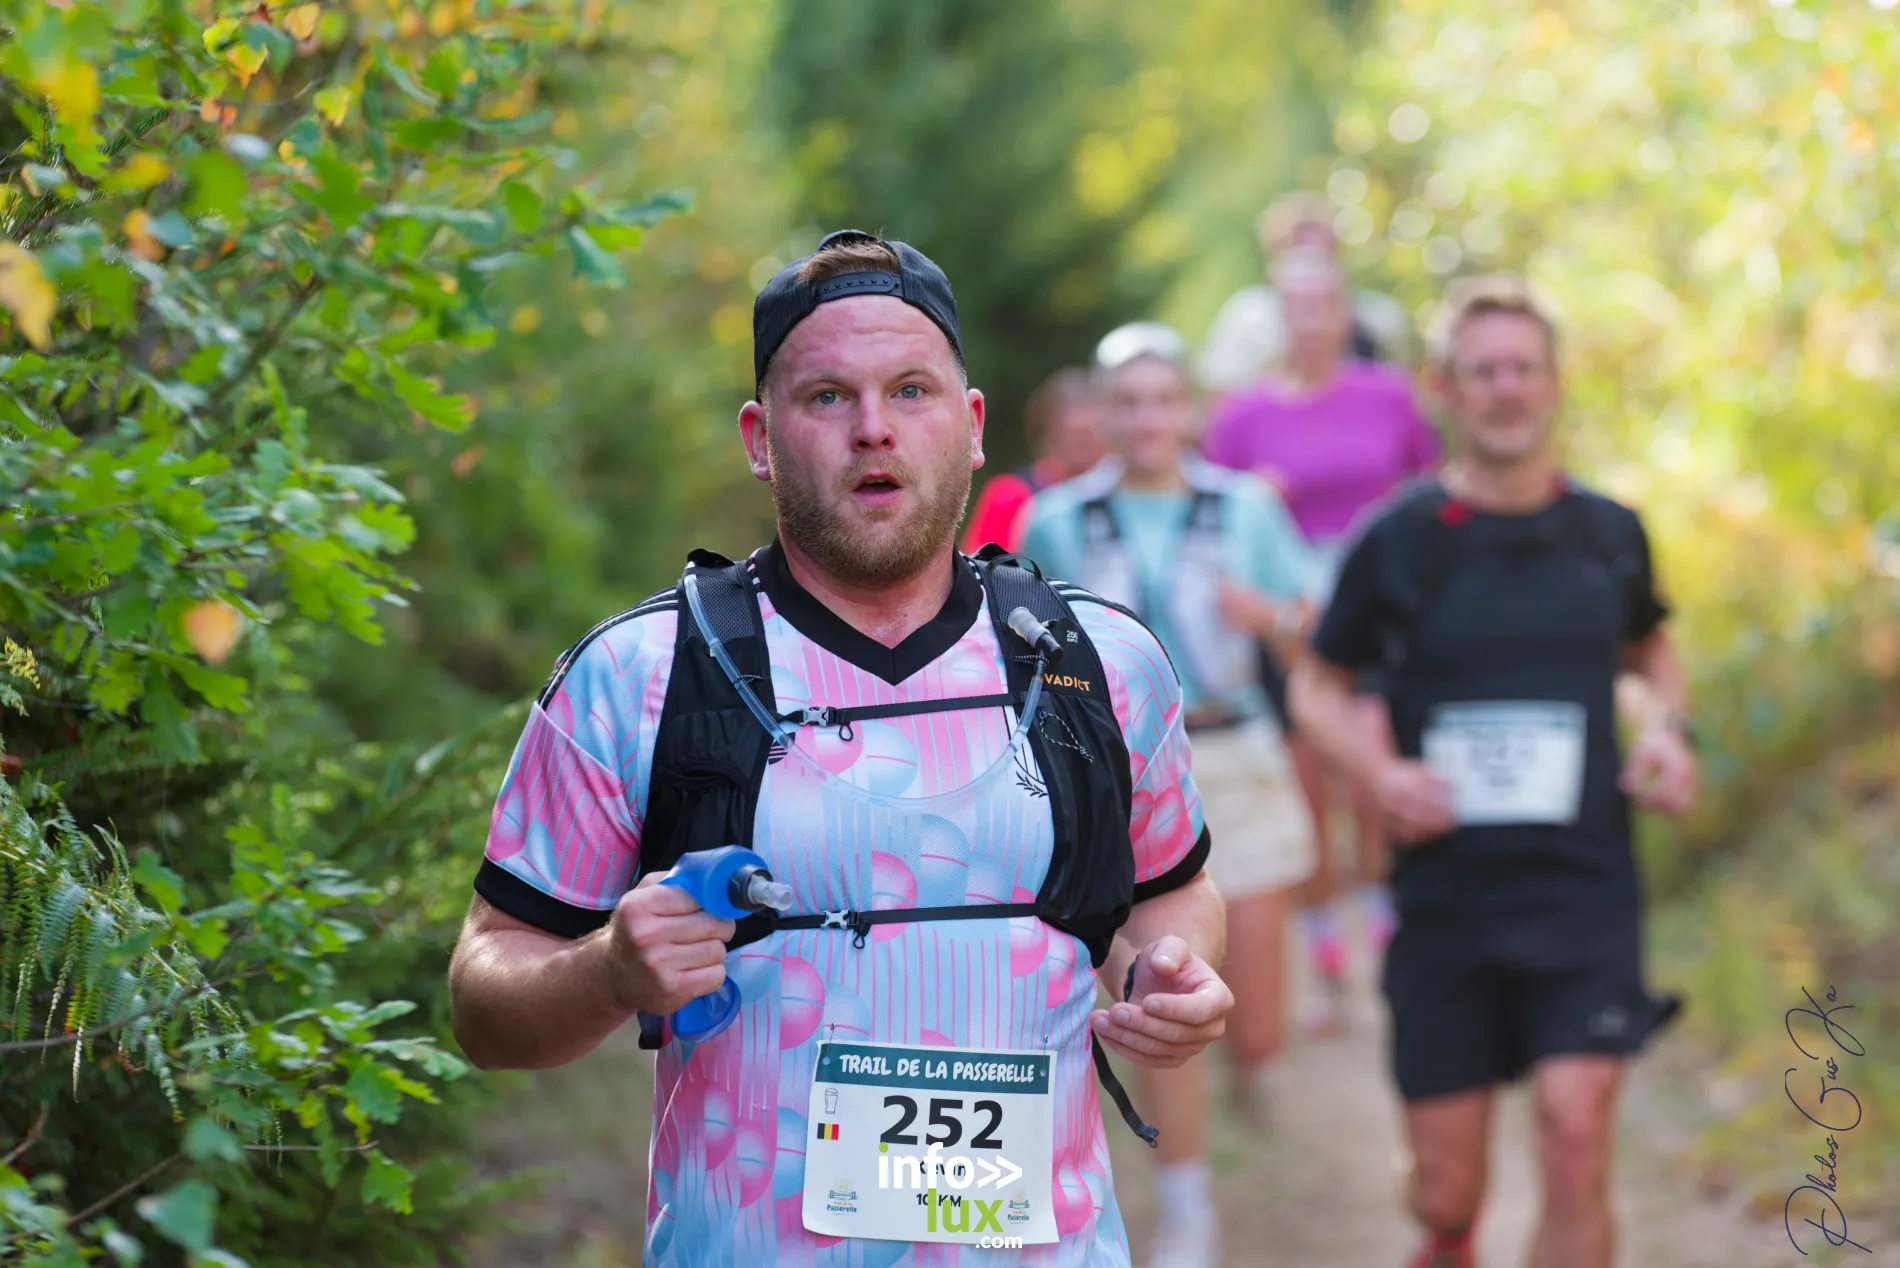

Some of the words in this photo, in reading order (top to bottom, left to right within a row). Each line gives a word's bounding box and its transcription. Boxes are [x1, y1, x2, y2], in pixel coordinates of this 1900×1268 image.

[1040, 673, 1090, 692] VADICT
[839, 1054, 892, 1076] TRAIL
[897, 1058, 921, 1078] DE
[925, 1060, 948, 1079] LA
[952, 1061, 1035, 1083] PASSERELLE
[880, 1094, 1004, 1150] 252
[826, 1204, 858, 1213] Passerelle
[937, 1194, 962, 1208] KM
